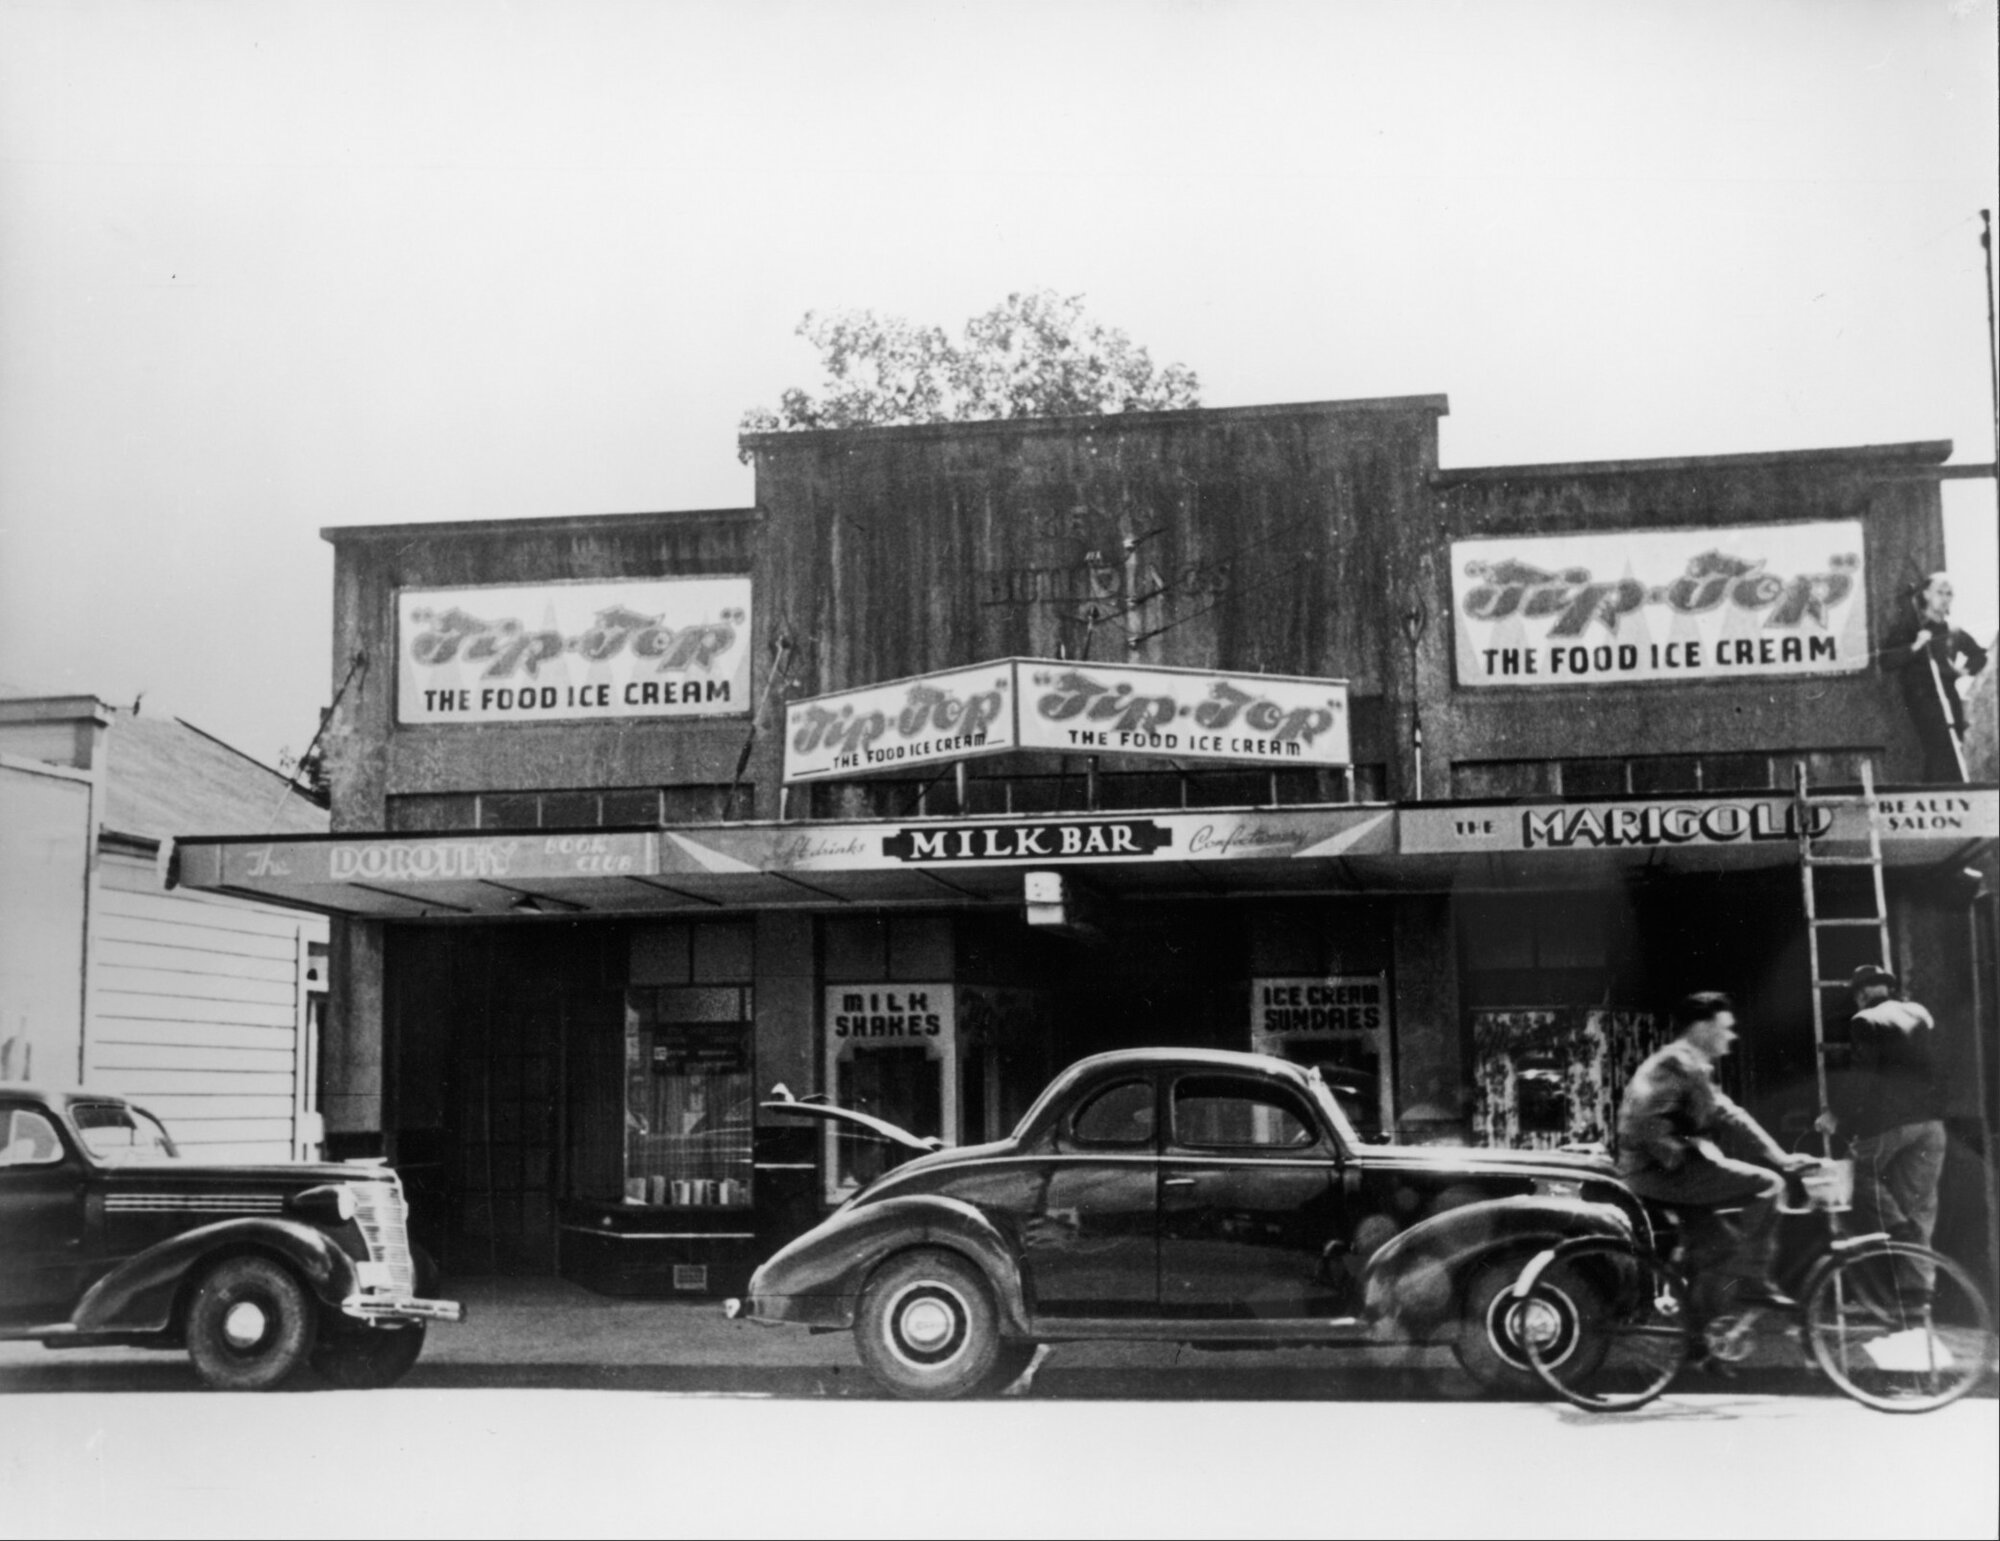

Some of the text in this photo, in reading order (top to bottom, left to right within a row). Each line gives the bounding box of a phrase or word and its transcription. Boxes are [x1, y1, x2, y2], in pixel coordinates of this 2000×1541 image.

[1483, 635, 1837, 675] THE FOOD ICE CREAM
[424, 680, 731, 712] THE FOOD ICE CREAM
[833, 733, 986, 769] THE FOOD ICE CREAM
[1068, 729, 1301, 757] THE FOOD ICE CREAM
[1879, 798, 1970, 814] BEAUTY
[1455, 803, 1833, 849] THE MARIGOLD
[1888, 816, 1962, 830] SALON
[909, 824, 1143, 859] MILK BAR
[246, 847, 292, 877] The
[577, 853, 632, 872] CLUB
[843, 992, 928, 1012] MILK
[1264, 984, 1380, 1006] ICE CREAM
[835, 1014, 941, 1037] SHAKES
[1264, 1006, 1381, 1032] SUNDAES
